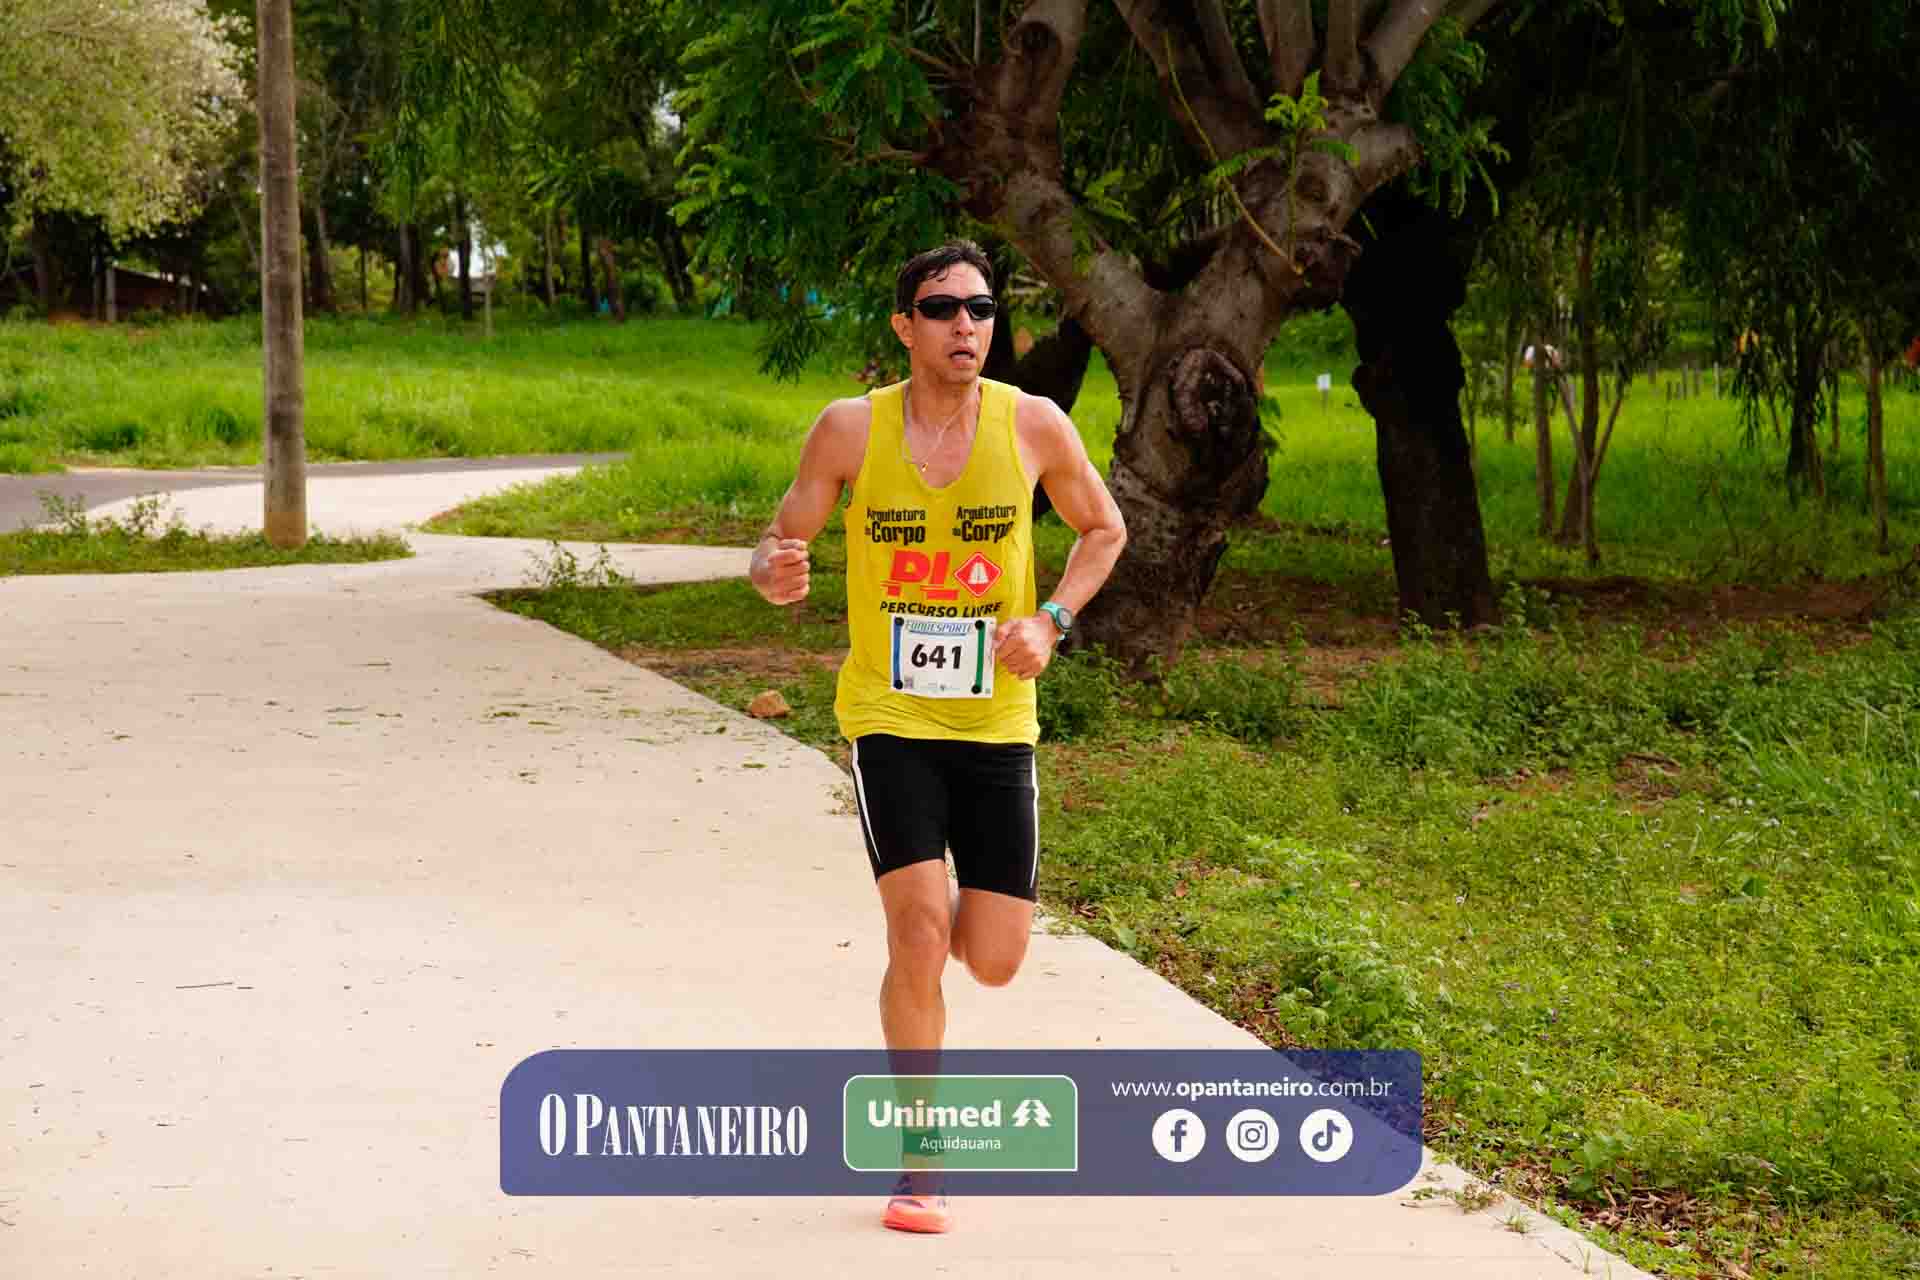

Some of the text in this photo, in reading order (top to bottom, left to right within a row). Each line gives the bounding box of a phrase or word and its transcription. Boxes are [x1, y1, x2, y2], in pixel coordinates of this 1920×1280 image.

[867, 507, 925, 523] Arquitetura
[956, 505, 1016, 521] Arquitetura
[872, 521, 925, 546] Corpo
[880, 602, 1004, 618] PERCURSO LIVRE
[911, 643, 962, 669] 641
